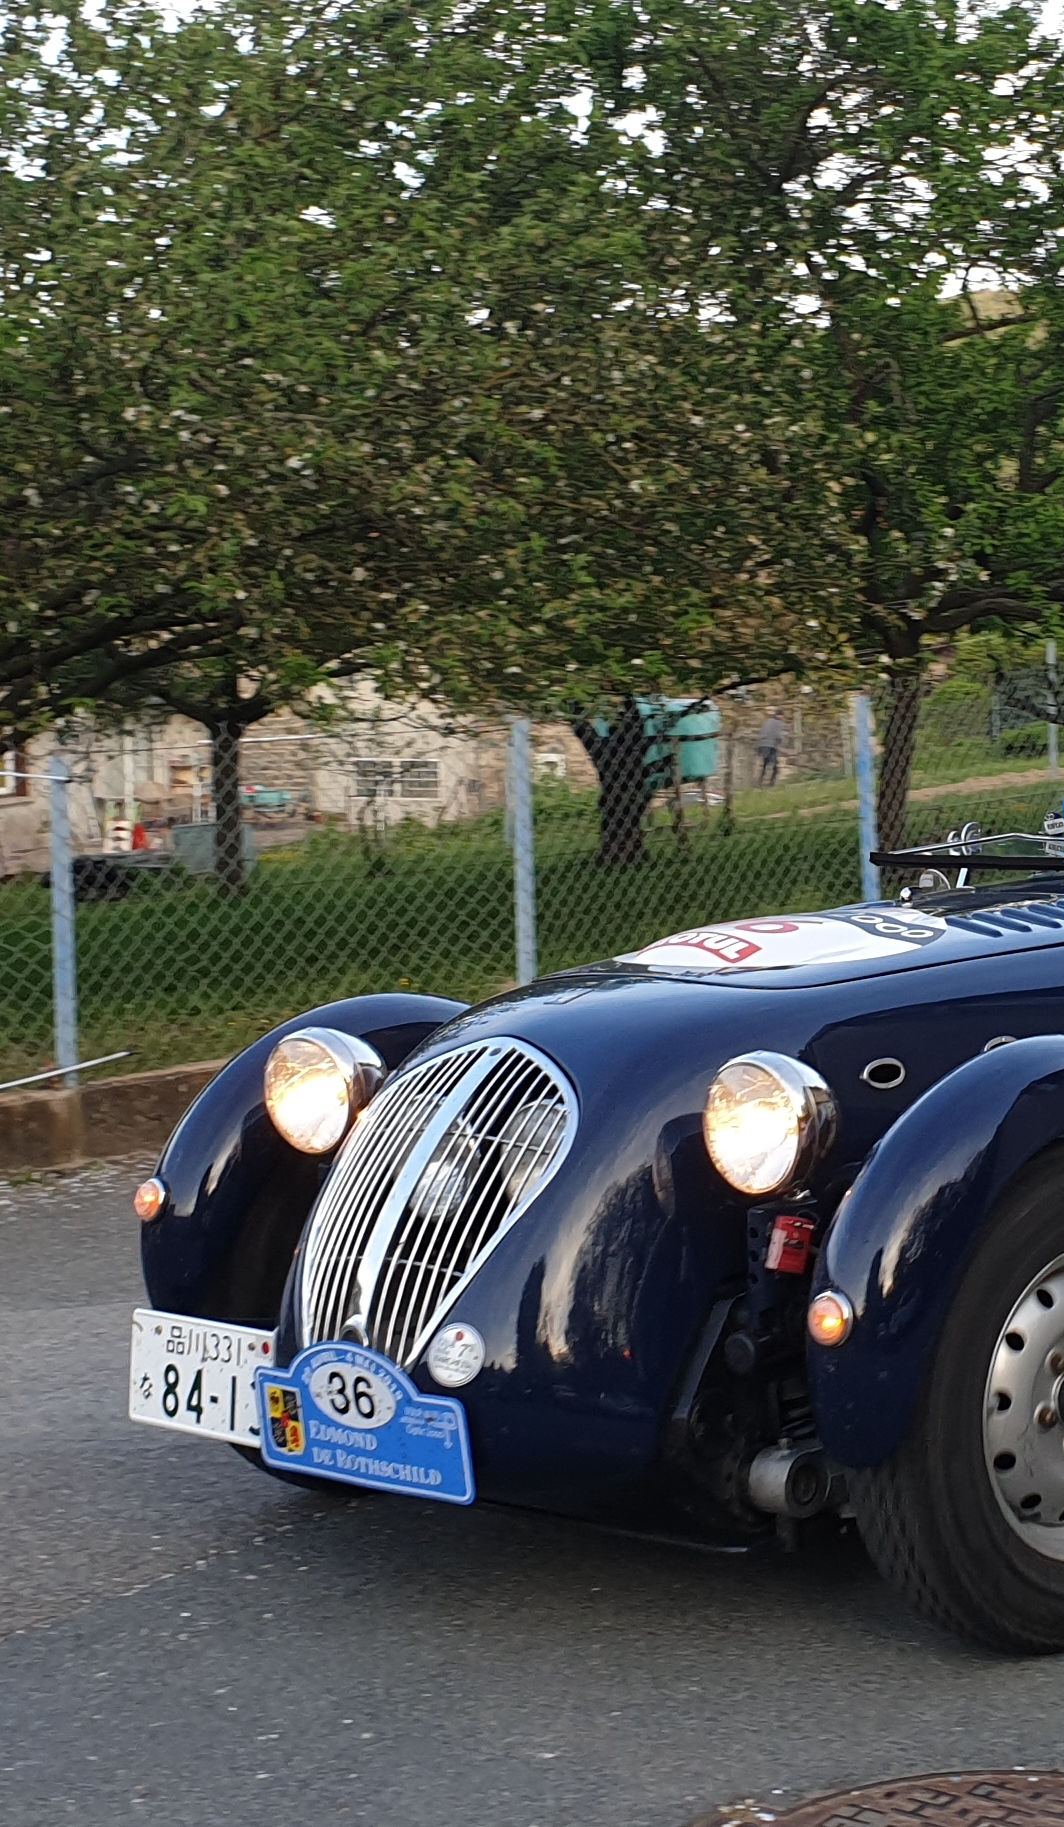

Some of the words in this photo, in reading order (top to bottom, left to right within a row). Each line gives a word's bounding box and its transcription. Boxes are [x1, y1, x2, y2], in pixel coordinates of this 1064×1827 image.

[828, 914, 934, 939] 000
[656, 932, 750, 960] OTUL
[162, 1363, 261, 1437] 84-1
[328, 1371, 375, 1419] 36
[308, 1420, 378, 1451] EDMOND
[333, 1449, 442, 1486] ROTHSCHILD
